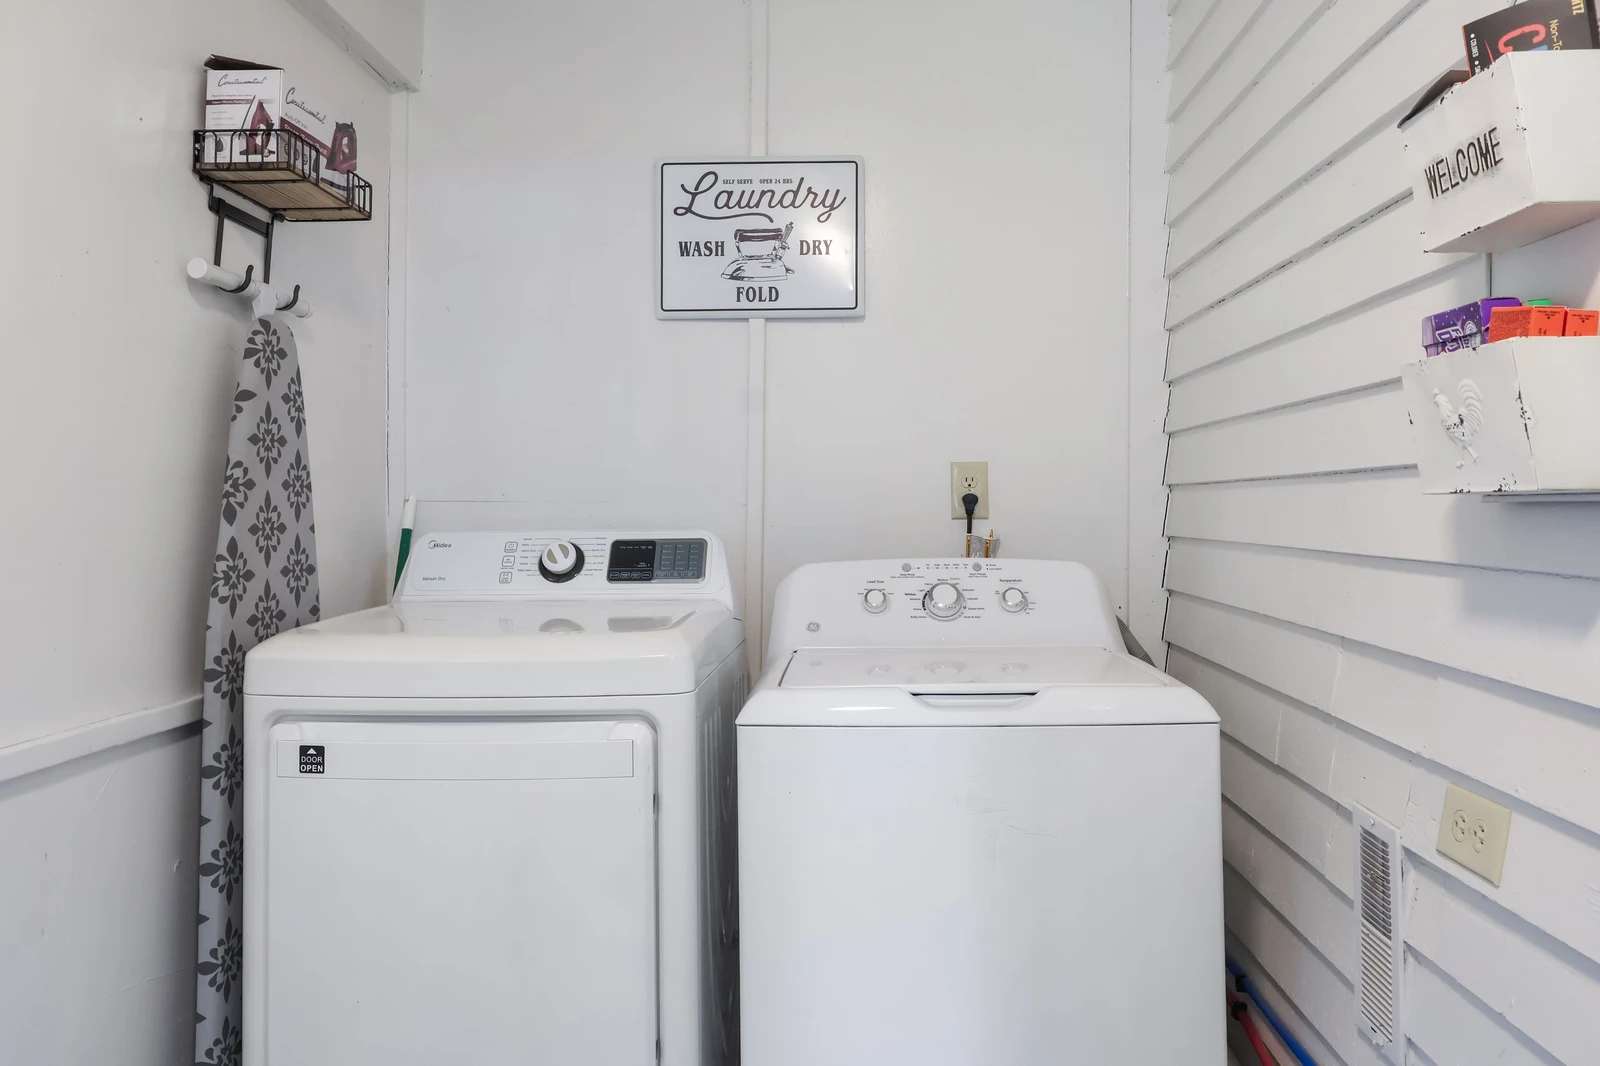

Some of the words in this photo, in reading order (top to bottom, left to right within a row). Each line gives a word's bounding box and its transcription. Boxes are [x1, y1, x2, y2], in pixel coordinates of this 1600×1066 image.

[1549, 19, 1562, 50] Non-To
[1424, 126, 1503, 199] WELCOME
[673, 171, 846, 223] Laundry
[678, 240, 725, 257] WASH
[799, 239, 833, 256] DRY
[736, 286, 779, 303] FOLD
[300, 755, 323, 763] DOOR
[300, 764, 324, 773] OPEN
